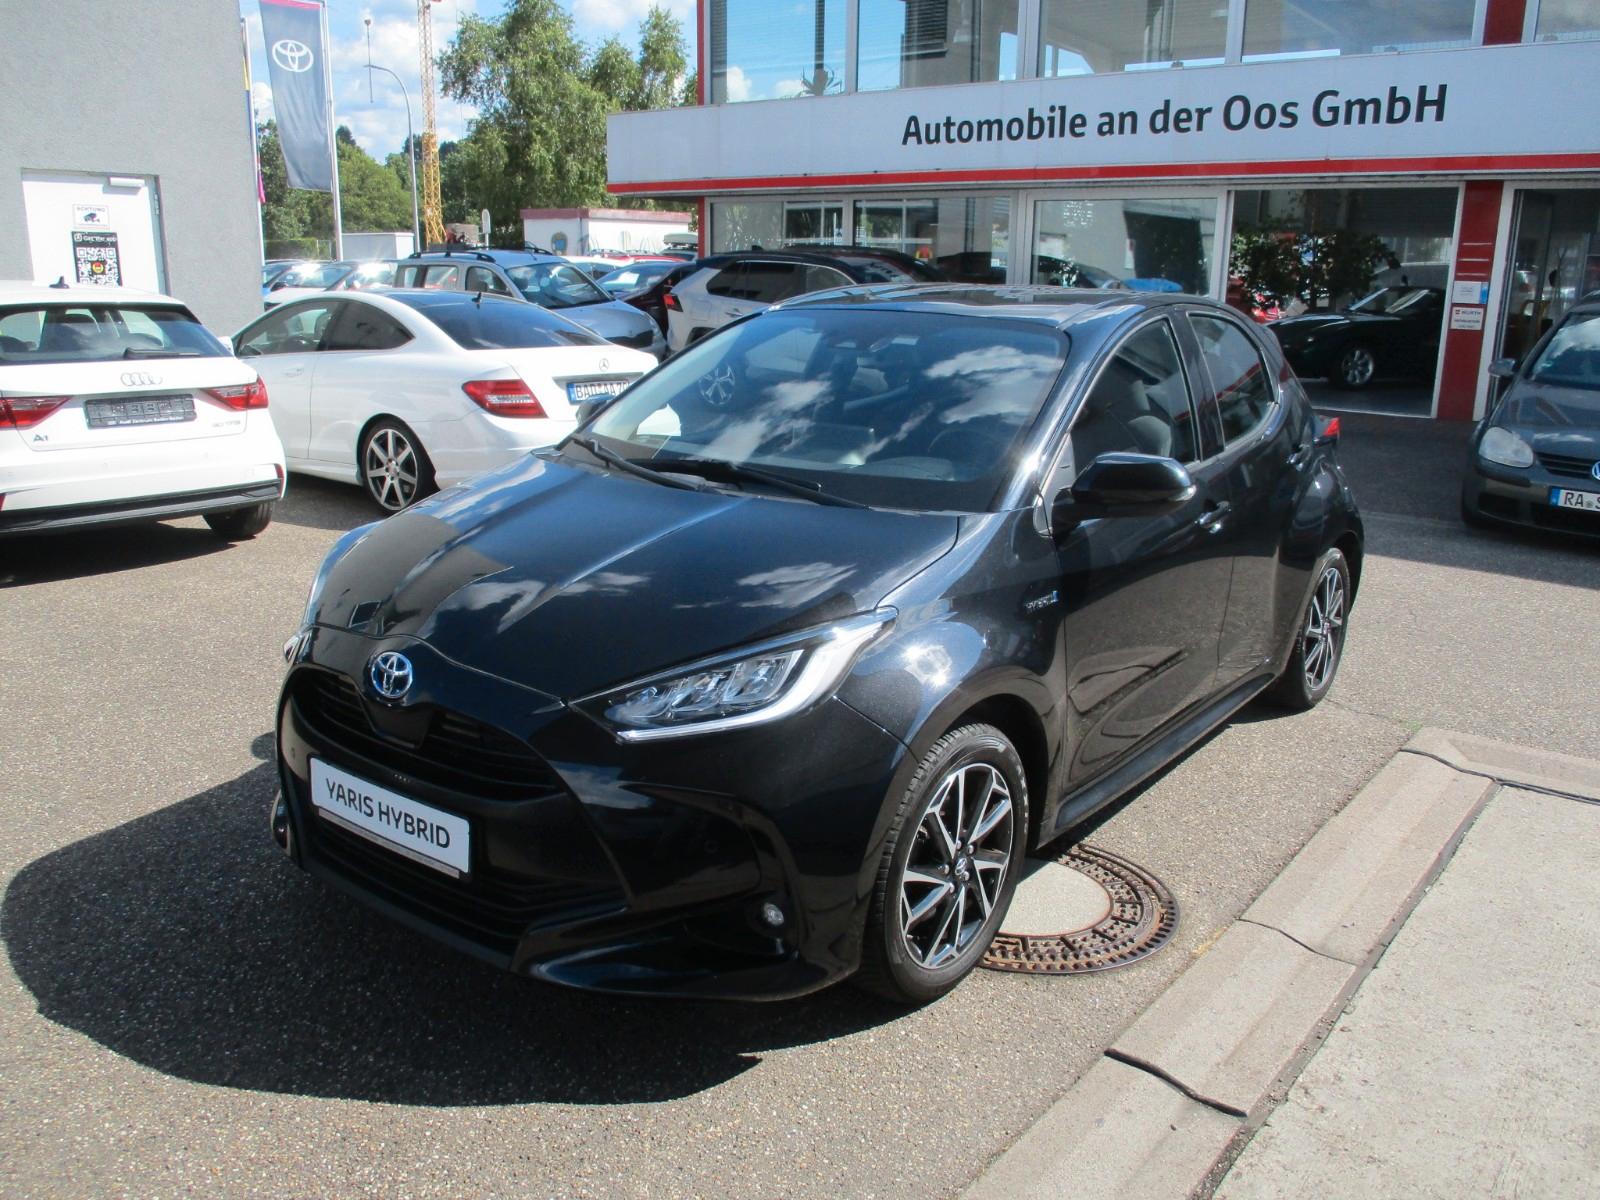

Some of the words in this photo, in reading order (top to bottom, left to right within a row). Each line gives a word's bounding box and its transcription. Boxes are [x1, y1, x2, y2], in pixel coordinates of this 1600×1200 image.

[902, 105, 1087, 145] Automobile
[1097, 109, 1138, 137] an
[1149, 99, 1213, 134] der
[1222, 94, 1299, 131] Oos
[1312, 84, 1448, 127] GmbH
[33, 434, 48, 442] A1
[1564, 491, 1584, 507] RA
[325, 778, 374, 818] YARIS
[378, 801, 451, 849] HYBRID
